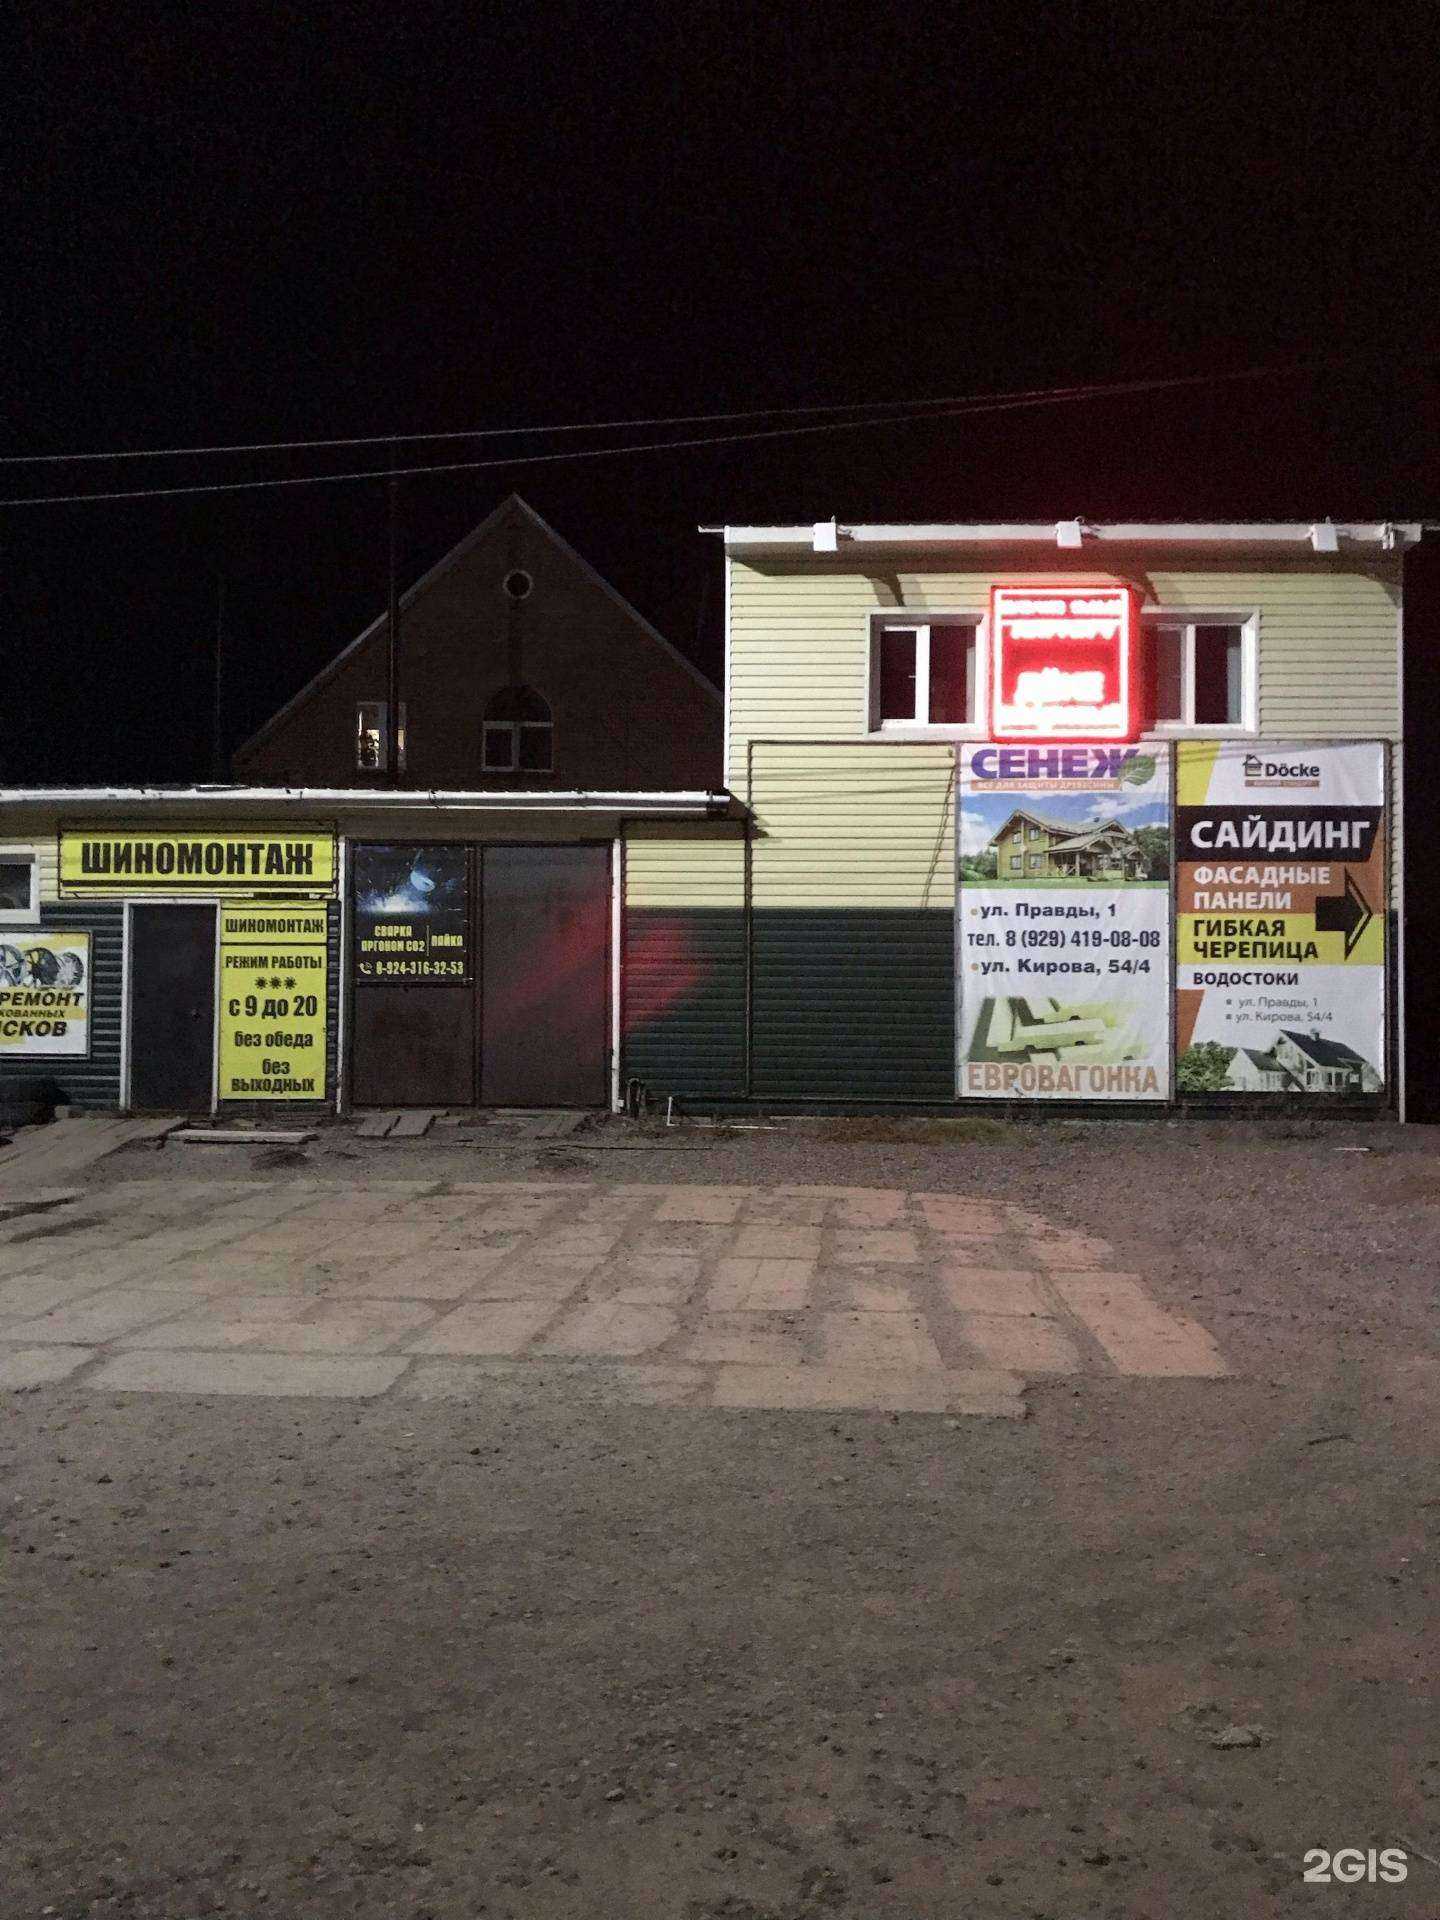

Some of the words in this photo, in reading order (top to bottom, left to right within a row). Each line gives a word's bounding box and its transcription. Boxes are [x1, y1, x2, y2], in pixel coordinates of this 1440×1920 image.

[971, 748, 1140, 779] СЕНЕЖ
[1265, 763, 1320, 777] Döcke
[1190, 815, 1370, 852] САЙДИНГ
[81, 842, 313, 875] ШИНОМОНТАЖ
[1194, 866, 1330, 888] ФАСАДНЫЕ
[1194, 892, 1291, 910] ПАНЕЛИ
[981, 905, 1008, 919] ул.
[1015, 903, 1100, 920] Правды,
[1108, 904, 1117, 917] 1
[225, 919, 324, 933] ШИНОМОНТАЖ
[374, 926, 413, 937] СВАРКА
[1194, 920, 1285, 936] ГИБКАЯ
[968, 931, 999, 946] тел.
[1006, 931, 1016, 947] 8
[1021, 930, 1066, 948] (929)
[1071, 931, 1160, 947] 419-08-08
[1193, 942, 1318, 961] ЧЕРЕПИЦА
[225, 956, 268, 968] РЕЖИМ
[272, 956, 322, 969] РАБОТЫ
[982, 961, 1009, 976] ул.
[1018, 959, 1100, 976] Кирова,
[1108, 959, 1150, 974] 54/4
[1193, 972, 1298, 986] ВОДОСТОКИ
[0, 992, 84, 1007] РЕМОНТ
[245, 996, 257, 1017] 9
[262, 999, 288, 1019] до
[293, 996, 317, 1016] 20
[0, 1020, 67, 1037] СКОВ
[235, 1031, 261, 1047] без
[266, 1031, 313, 1049] обеда
[262, 1059, 290, 1074] без
[232, 1079, 314, 1093] ВЫХОДНЫХ
[968, 1065, 1160, 1092] ЕВРОВАГОНКА
